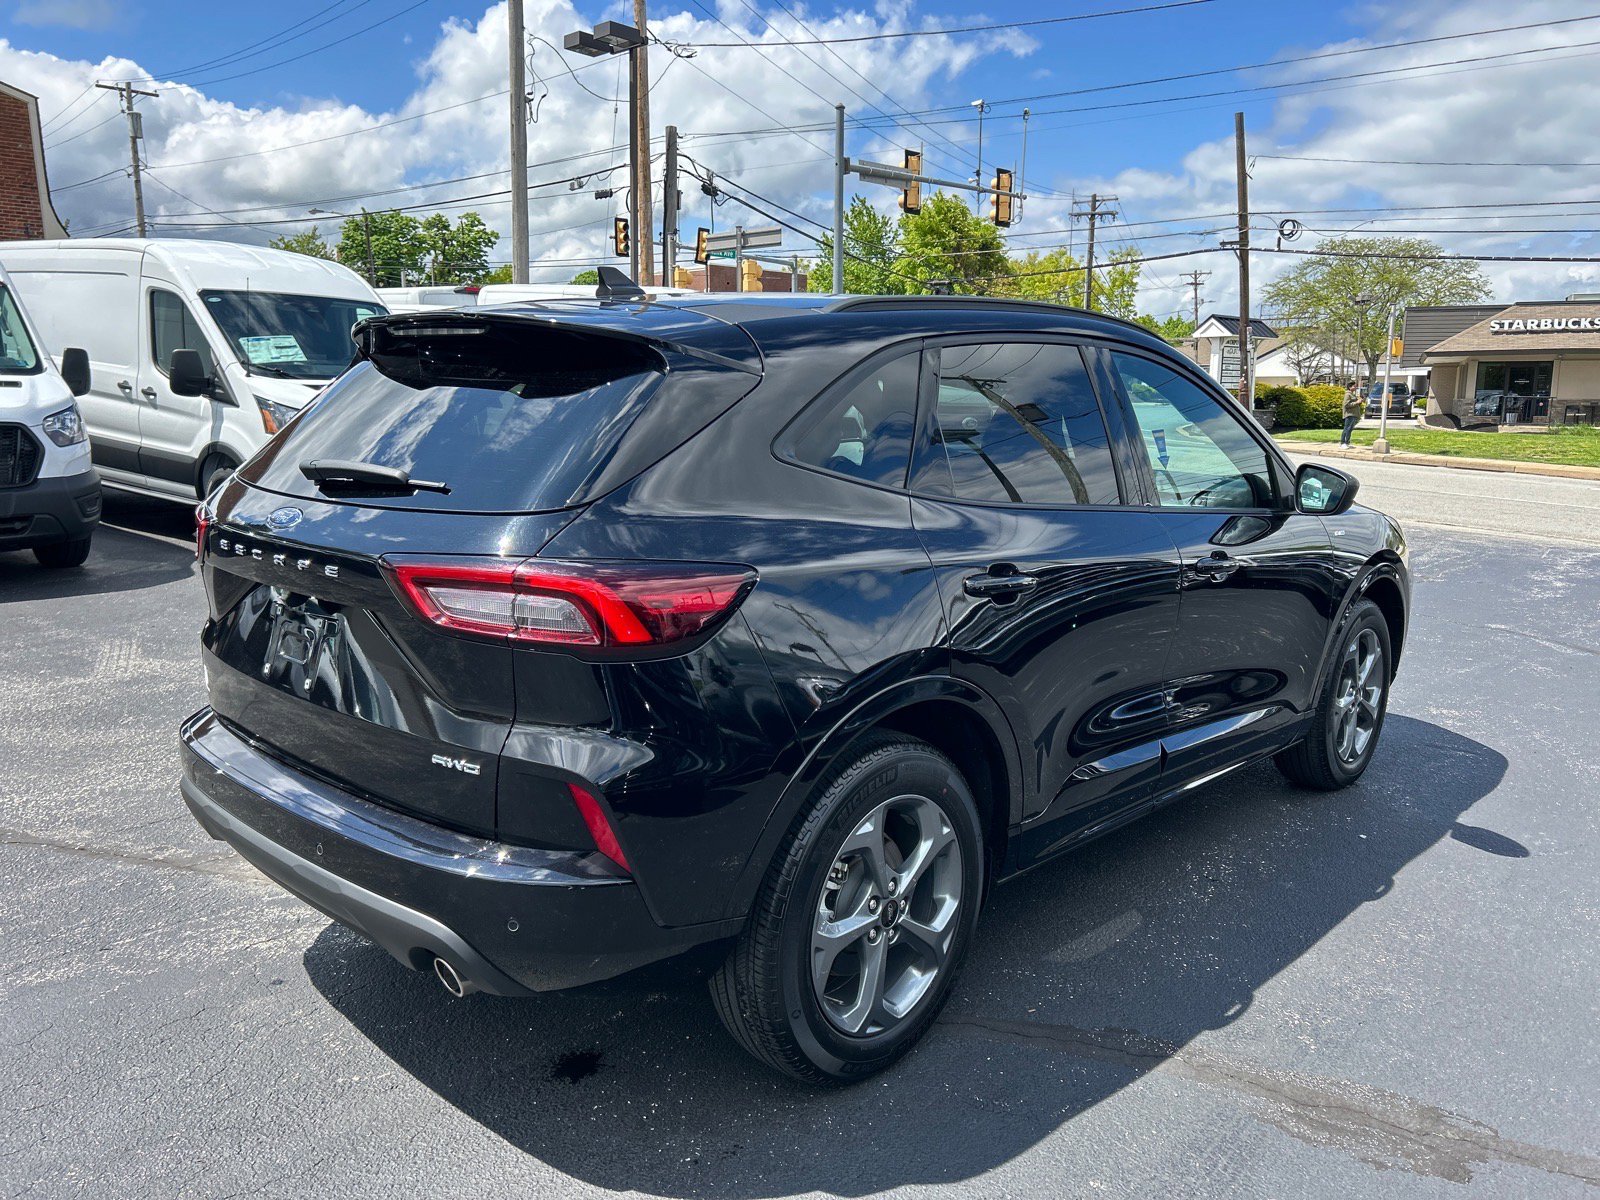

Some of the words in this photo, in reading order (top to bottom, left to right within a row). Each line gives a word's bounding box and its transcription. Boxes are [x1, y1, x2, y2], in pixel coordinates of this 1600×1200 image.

[1490, 318, 1600, 331] STARBUCKS
[220, 539, 339, 577] ESCAPE
[837, 767, 898, 828] MICHELIN
